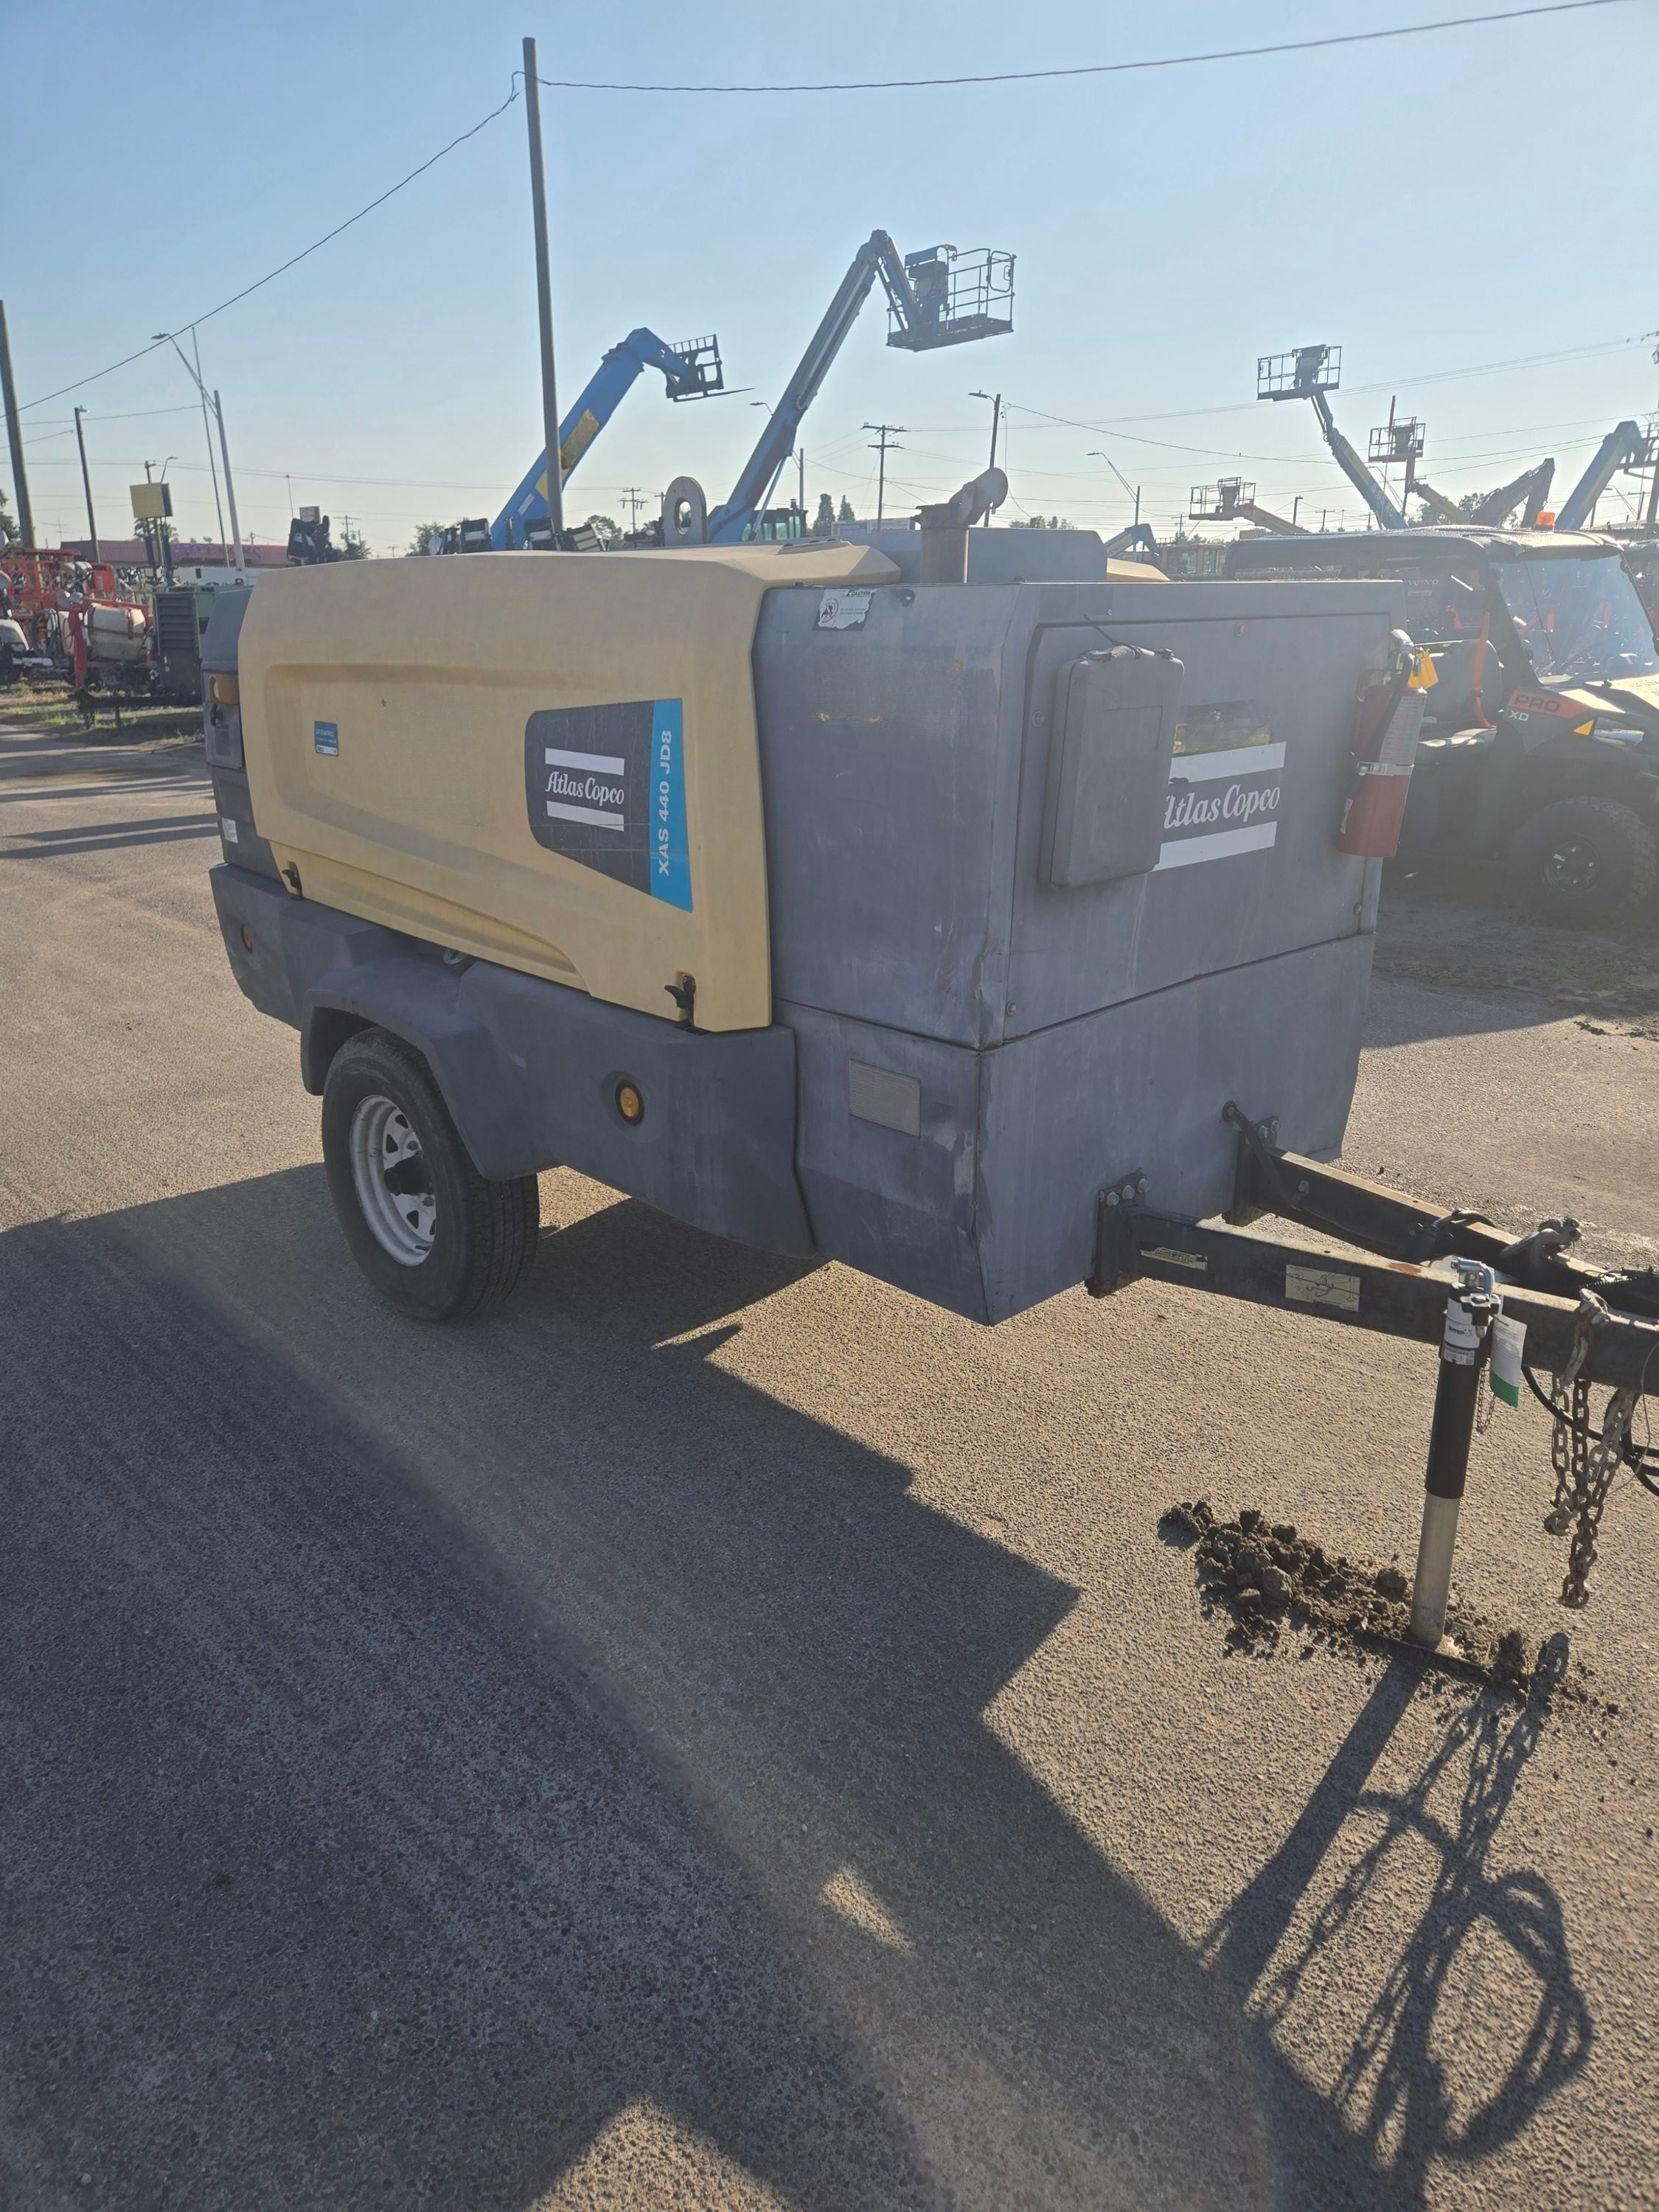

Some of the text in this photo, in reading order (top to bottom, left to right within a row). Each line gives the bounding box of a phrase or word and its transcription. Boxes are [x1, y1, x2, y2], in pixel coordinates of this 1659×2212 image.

[1509, 710, 1529, 721] XD
[1514, 694, 1561, 712] PRO
[546, 771, 625, 806] Atlas Copco
[658, 729, 672, 876] XAS 440 JD8
[1222, 784, 1281, 822] Copco
